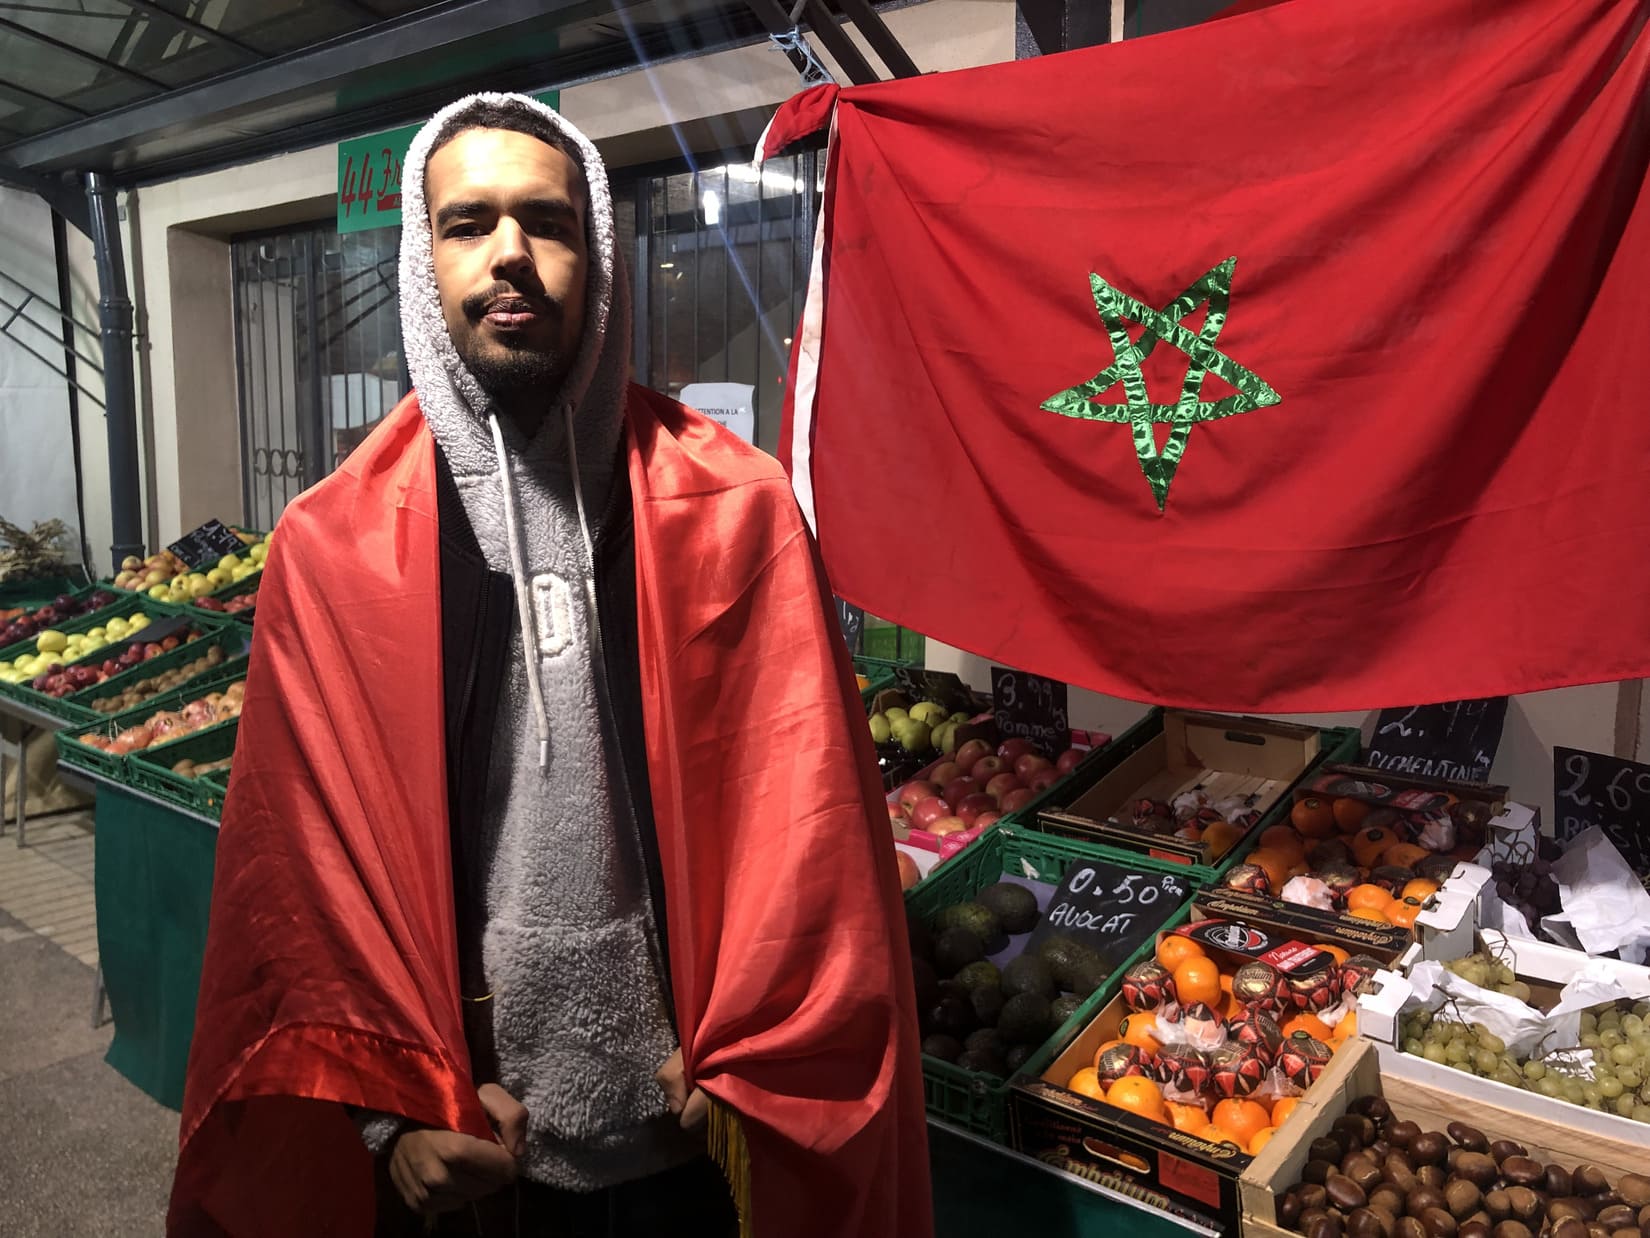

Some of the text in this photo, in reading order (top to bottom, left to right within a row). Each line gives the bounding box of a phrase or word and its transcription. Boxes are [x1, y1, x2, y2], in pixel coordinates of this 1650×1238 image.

[341, 152, 373, 218] 44
[731, 409, 739, 417] LA
[1069, 867, 1159, 905] 0.50
[1048, 902, 1137, 934] AVOCAT
